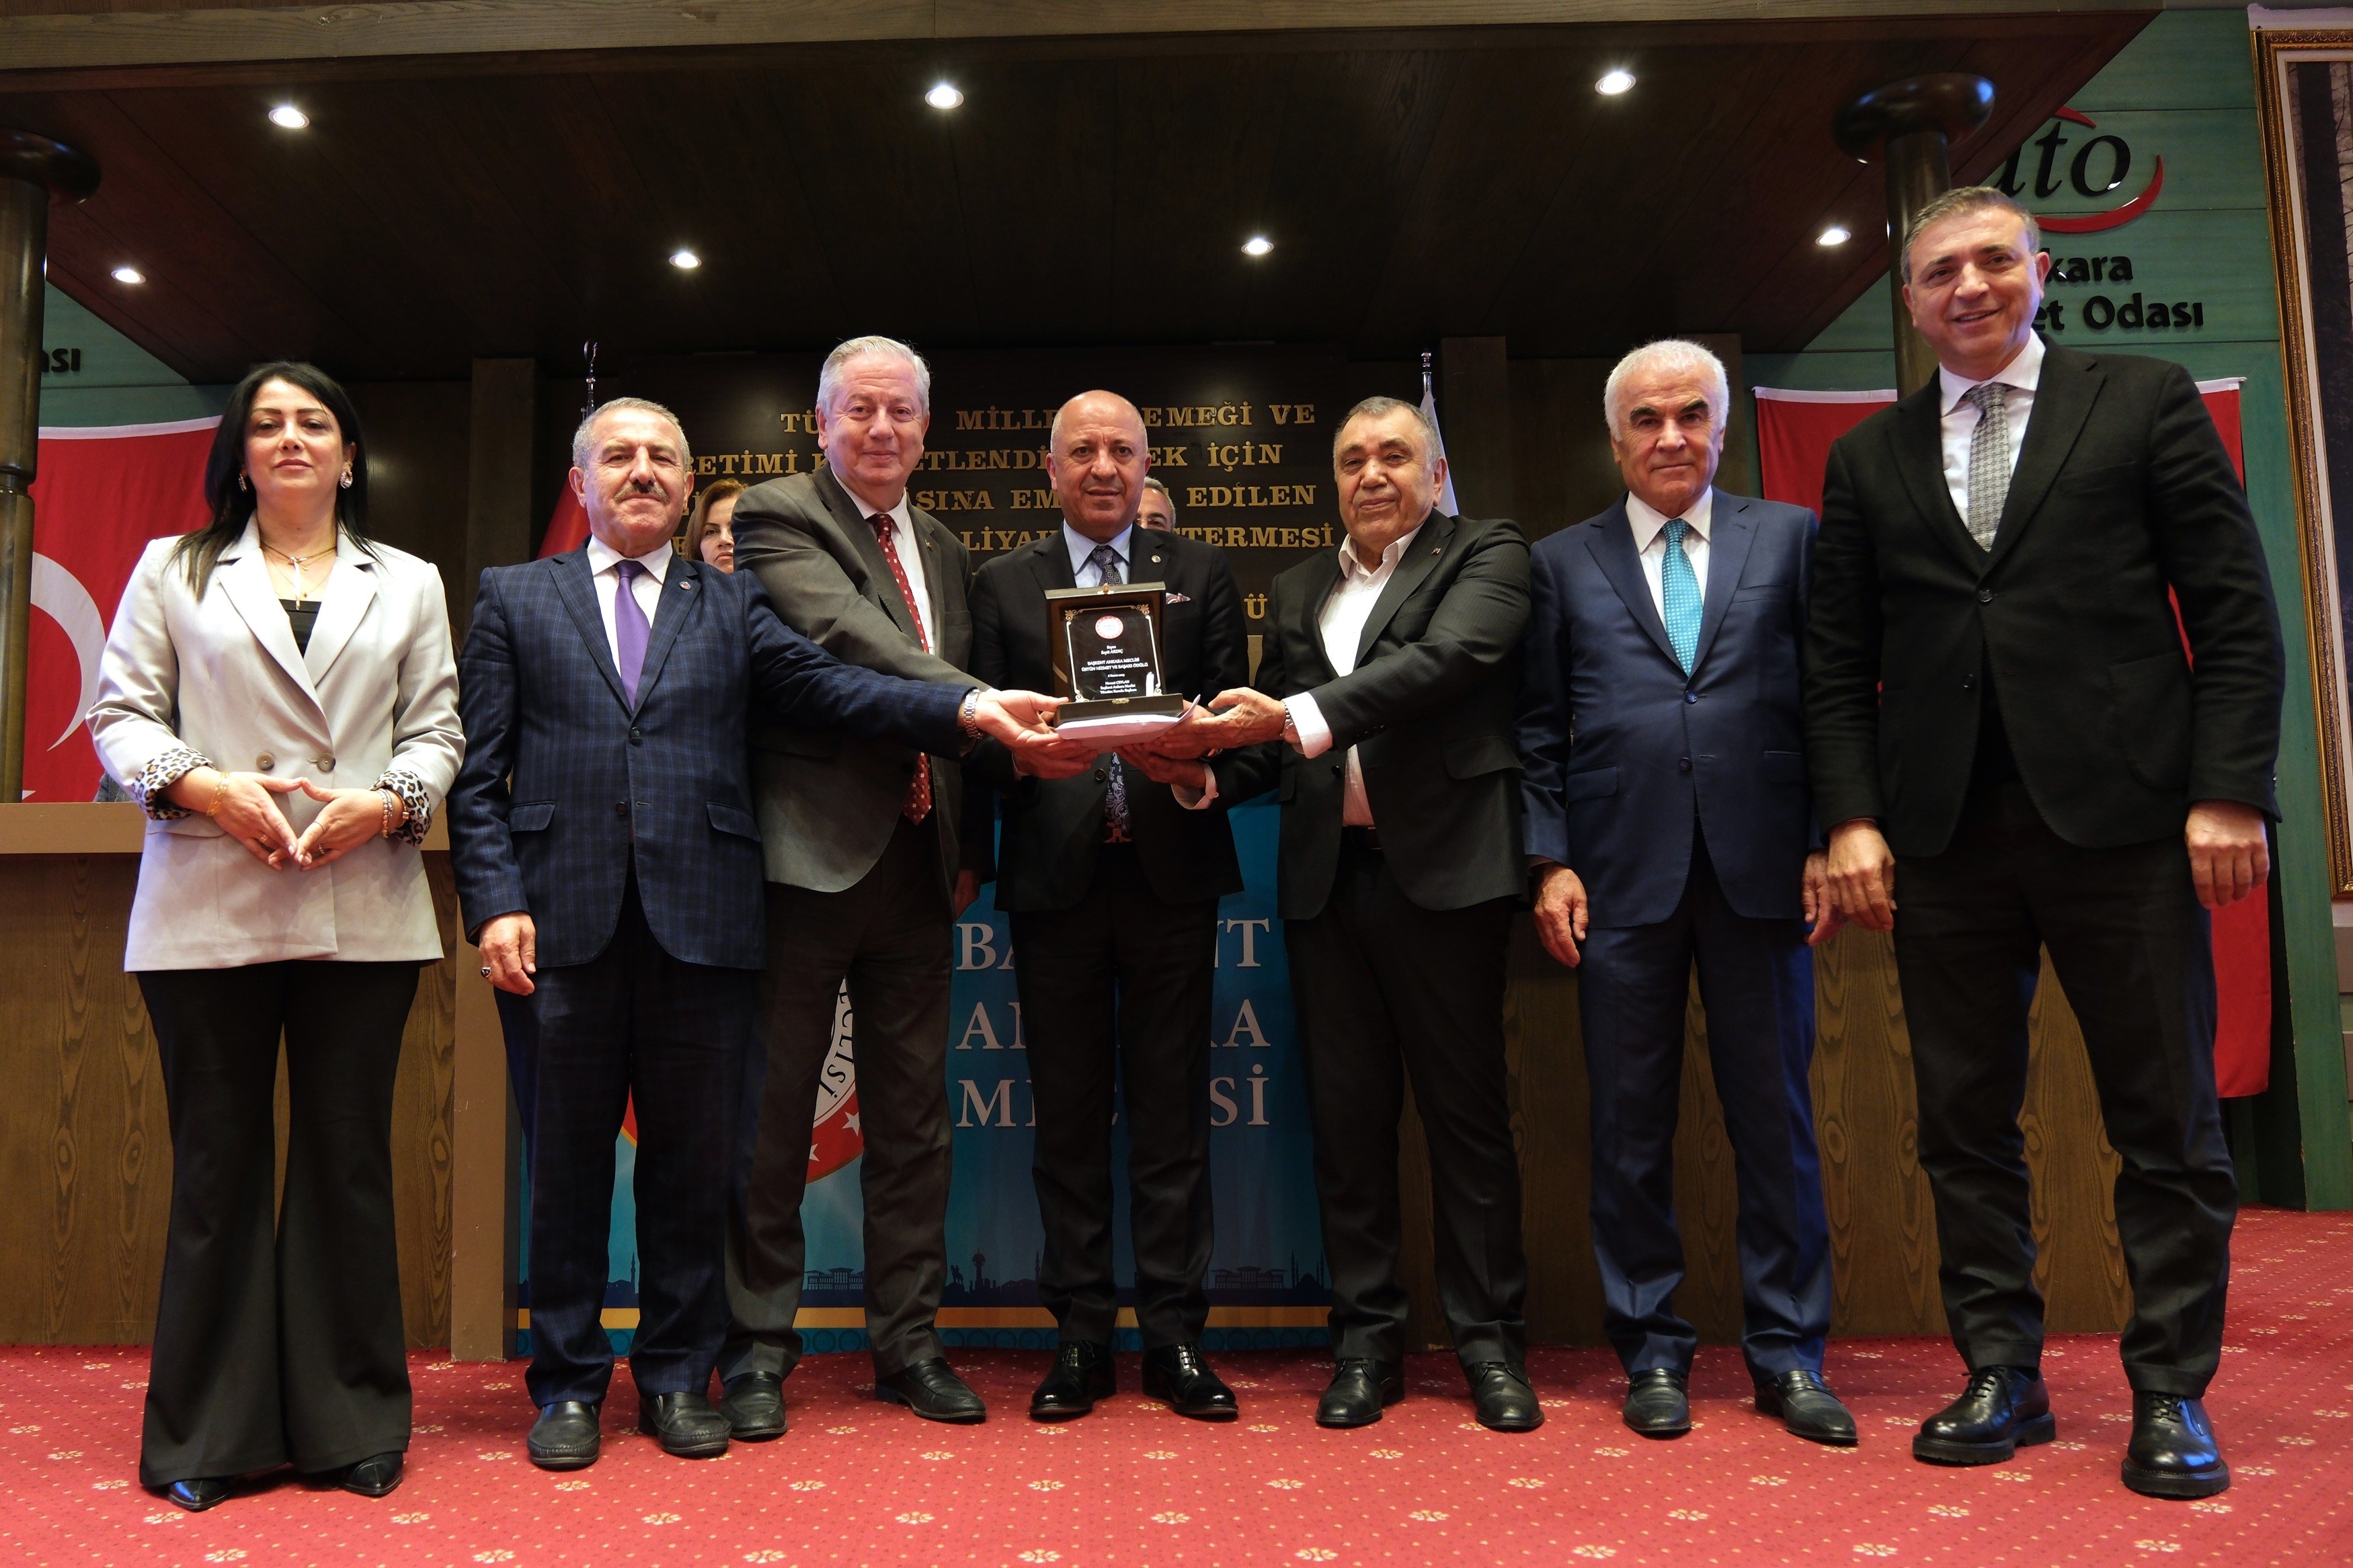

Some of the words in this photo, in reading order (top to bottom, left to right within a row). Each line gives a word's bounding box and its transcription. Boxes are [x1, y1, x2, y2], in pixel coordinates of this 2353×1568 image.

[2040, 247, 2134, 282] kara
[2083, 292, 2204, 329] Odası
[1142, 401, 1252, 427] EMEĞİ
[1269, 404, 1315, 425] VE
[690, 449, 798, 475] ETİMİ
[1207, 441, 1283, 472] İÇİN
[908, 489, 995, 511] SINA
[1187, 482, 1316, 507] EDİLEN
[961, 526, 1058, 551] LİYA
[1173, 522, 1334, 548] TERMESİ
